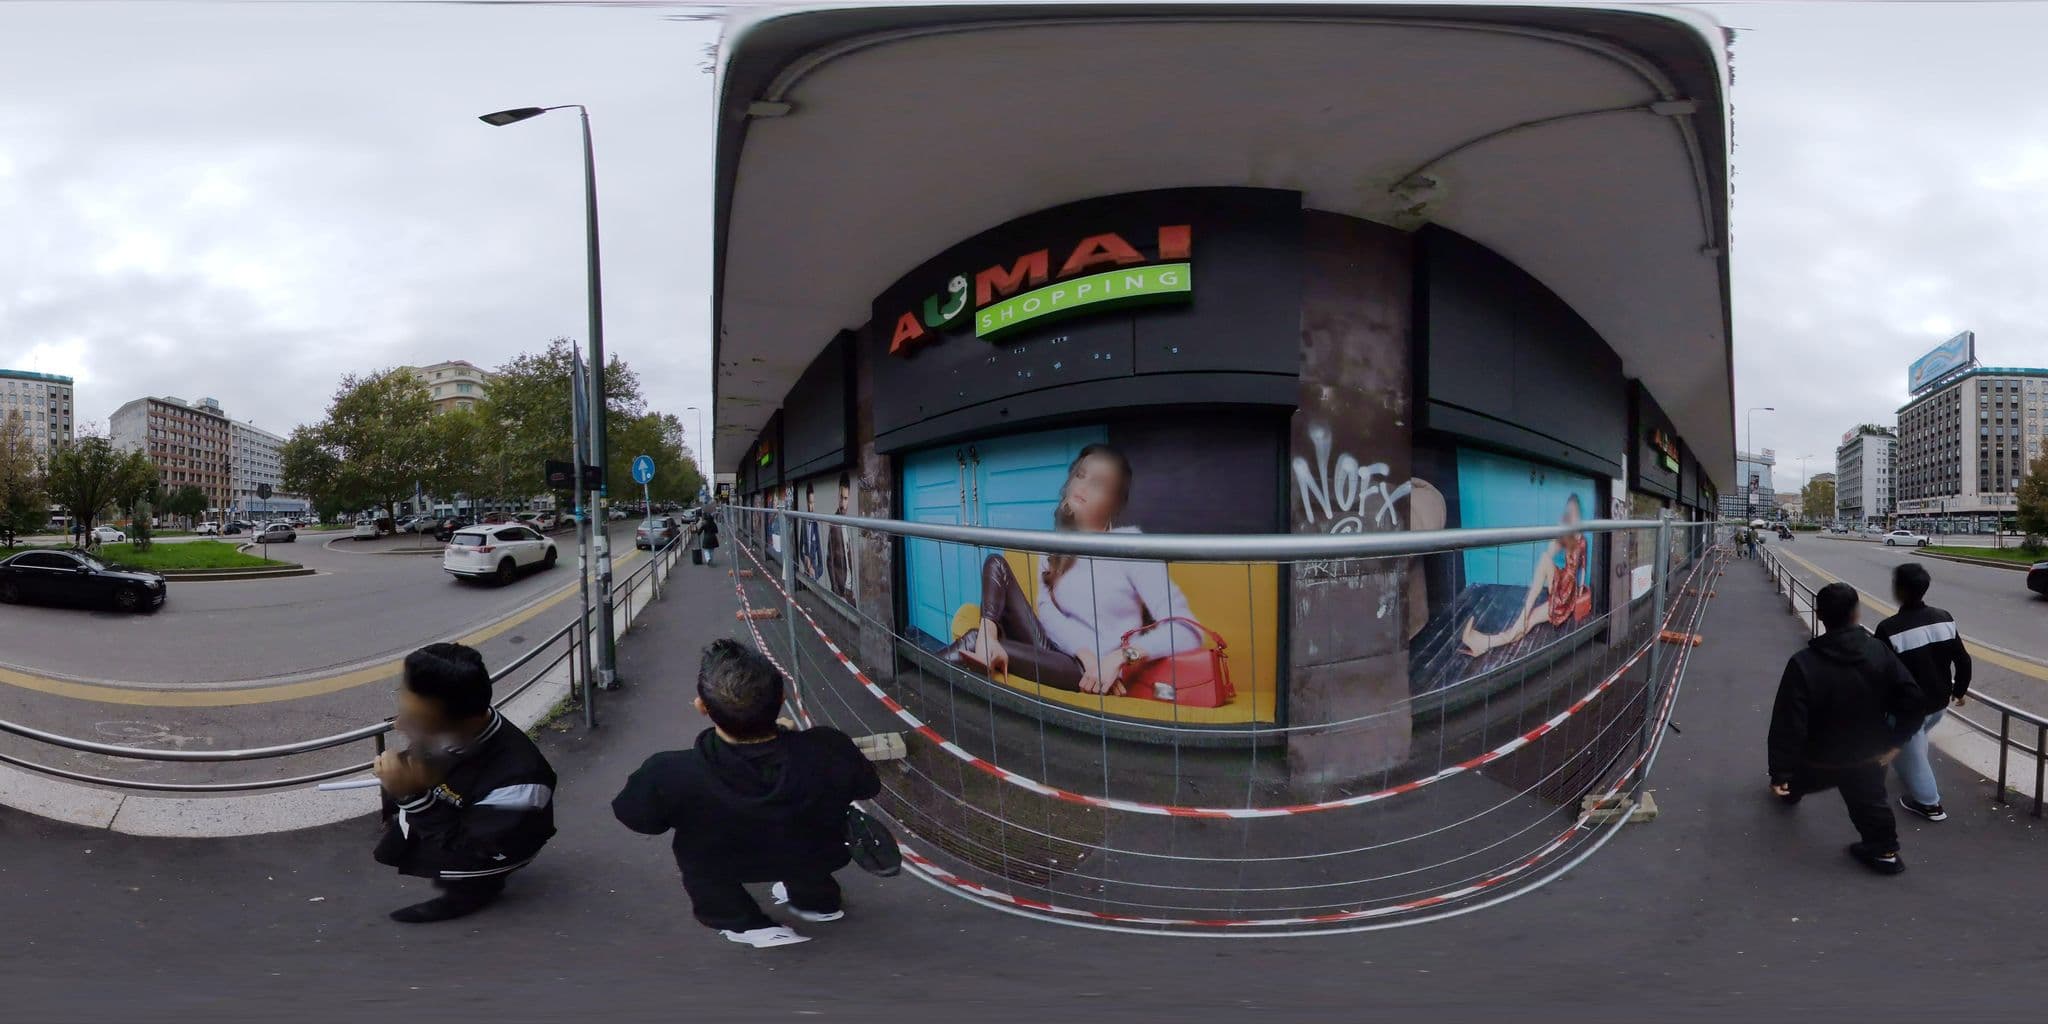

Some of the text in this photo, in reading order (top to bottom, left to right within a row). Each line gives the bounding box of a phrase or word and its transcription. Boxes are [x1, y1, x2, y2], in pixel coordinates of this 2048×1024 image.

[889, 224, 1192, 356] AUMAI
[981, 271, 1179, 329] SHOPPING
[1293, 424, 1412, 527] NOFX
